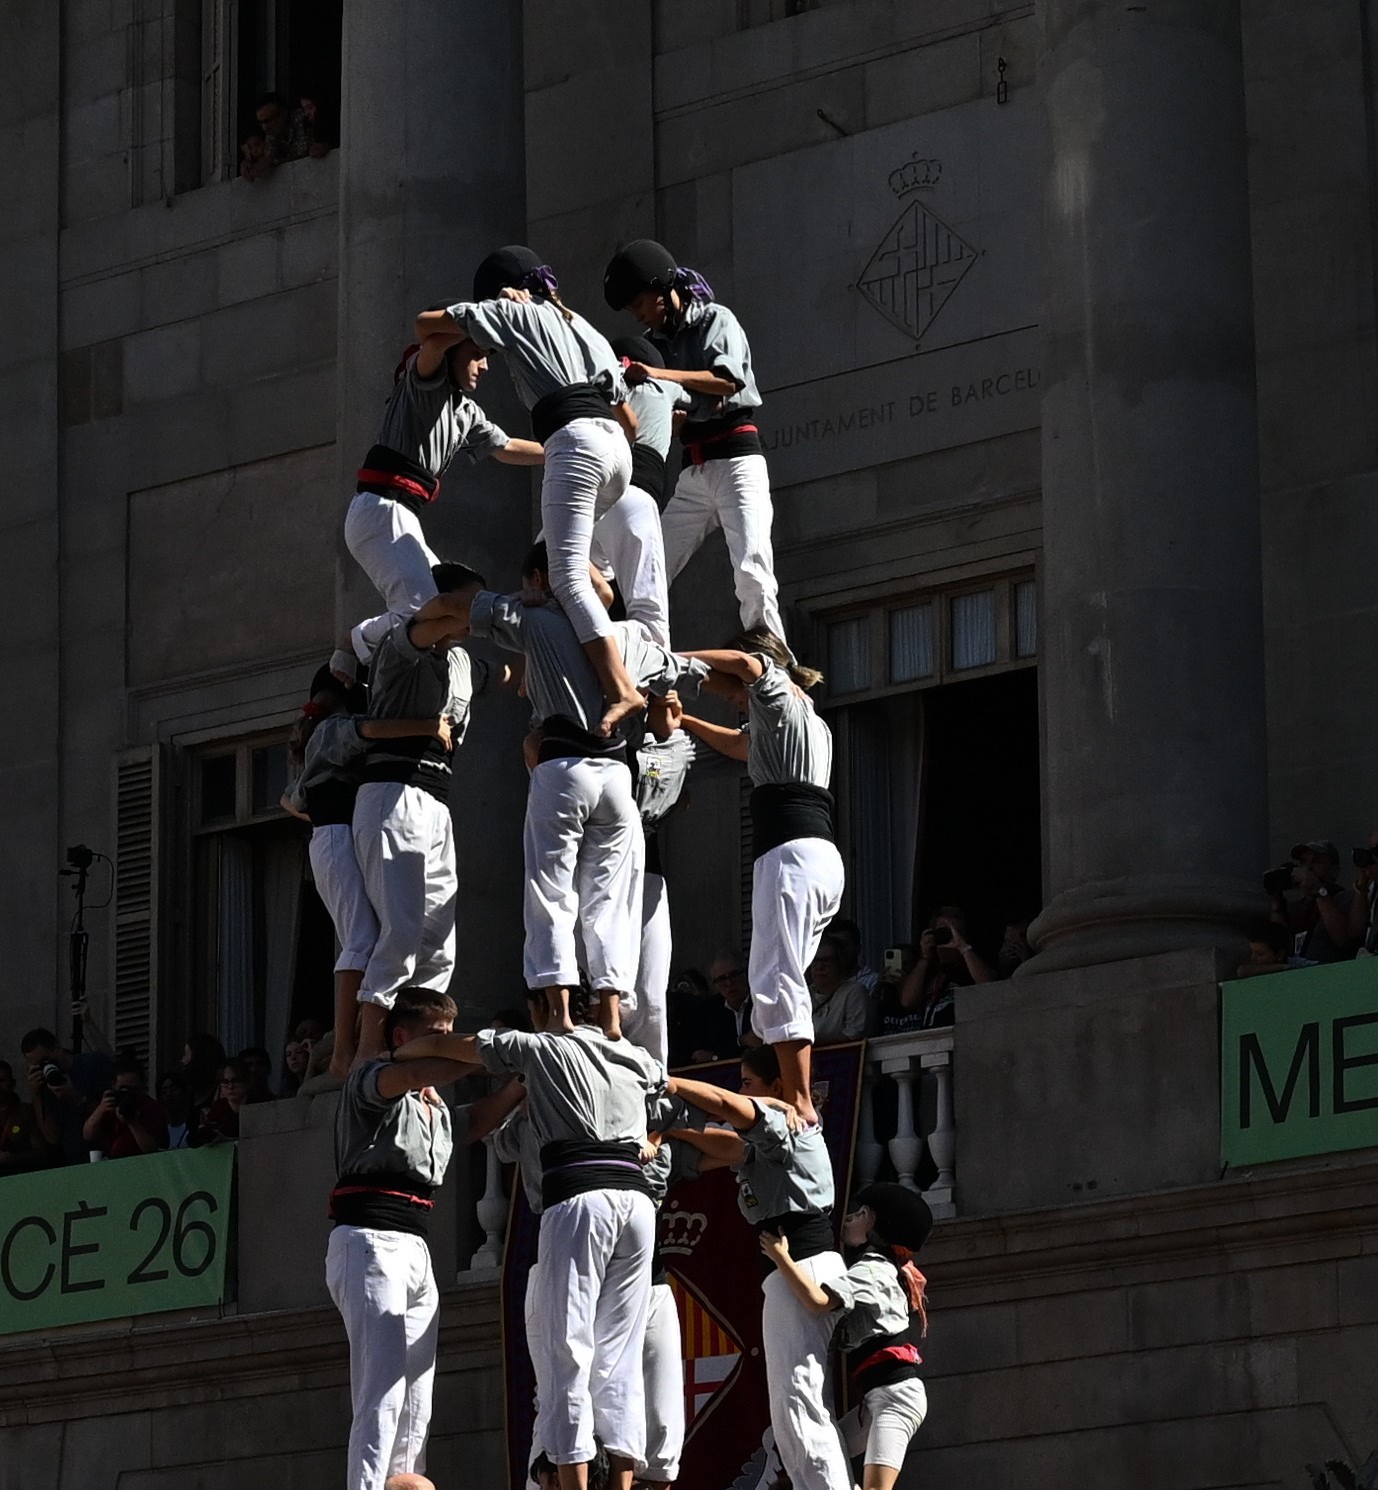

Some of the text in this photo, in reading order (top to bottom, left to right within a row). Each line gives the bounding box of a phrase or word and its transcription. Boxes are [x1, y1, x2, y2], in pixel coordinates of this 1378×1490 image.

[909, 391, 938, 417] DE
[951, 368, 1040, 405] BARCEL
[127, 1190, 218, 1284] 26
